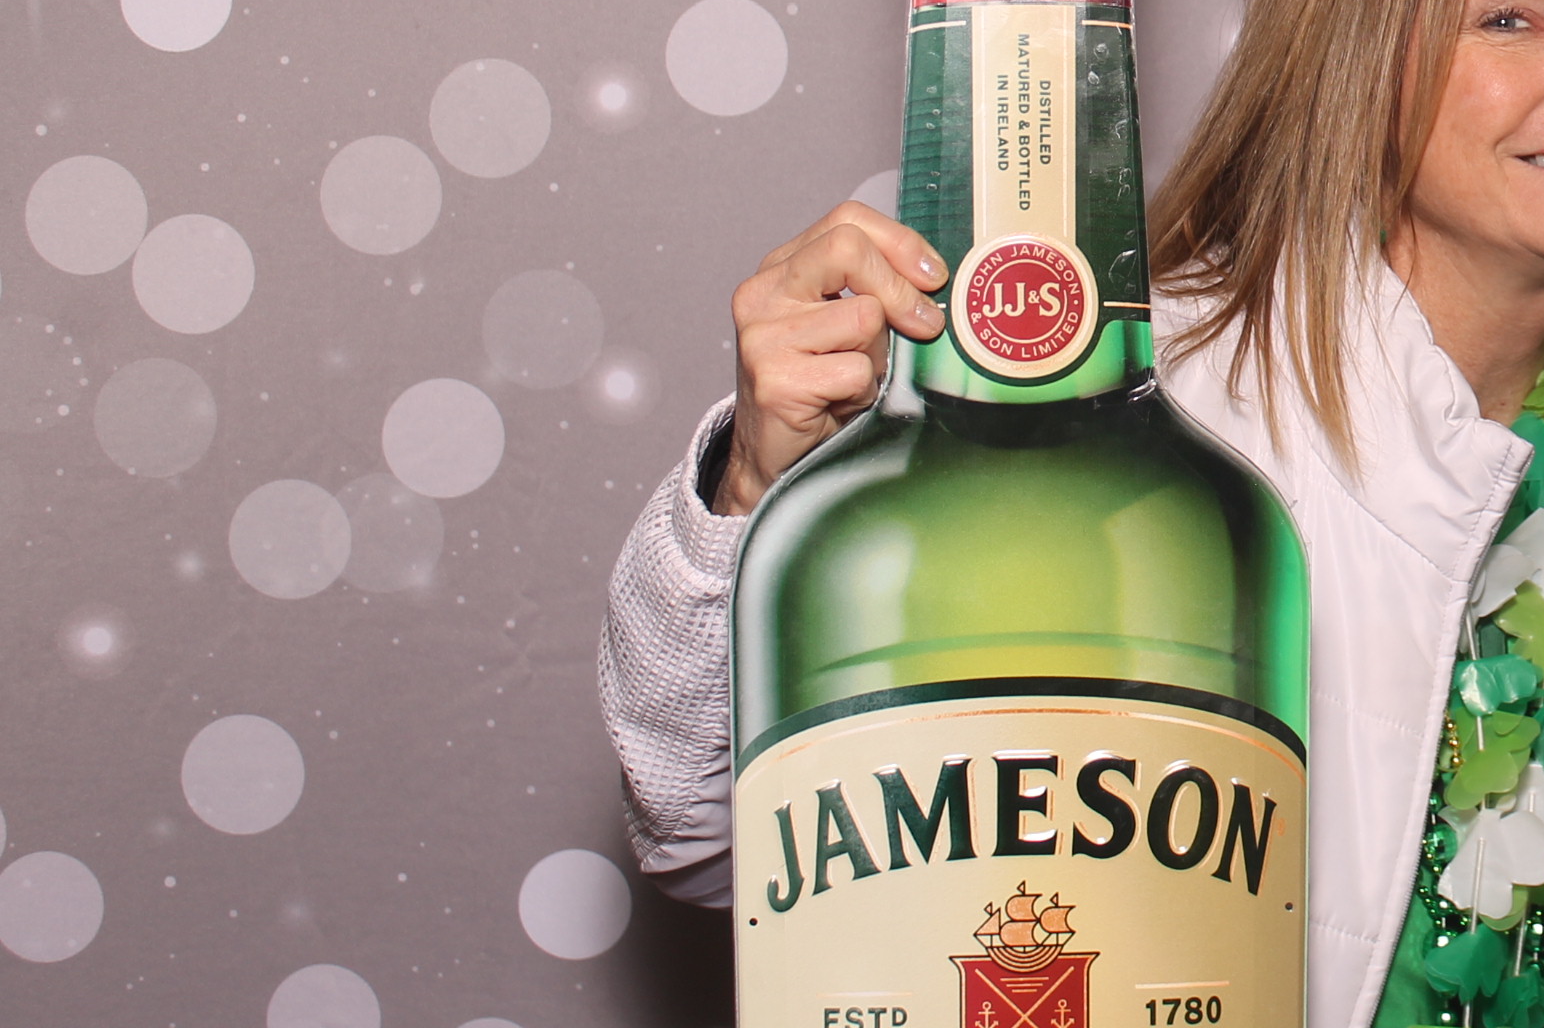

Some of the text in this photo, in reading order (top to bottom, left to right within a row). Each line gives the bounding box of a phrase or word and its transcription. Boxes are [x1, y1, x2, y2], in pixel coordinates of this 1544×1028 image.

[997, 75, 1009, 171] IN IRELAND
[1018, 34, 1030, 211] MATURED & BOTTLED
[1040, 80, 1051, 165] DISTILLED
[970, 245, 1080, 297] JOHN JAMESON
[971, 312, 1079, 358] & SON LIMITED
[767, 749, 1278, 913] JAMESON
[1145, 995, 1222, 1027] 1780
